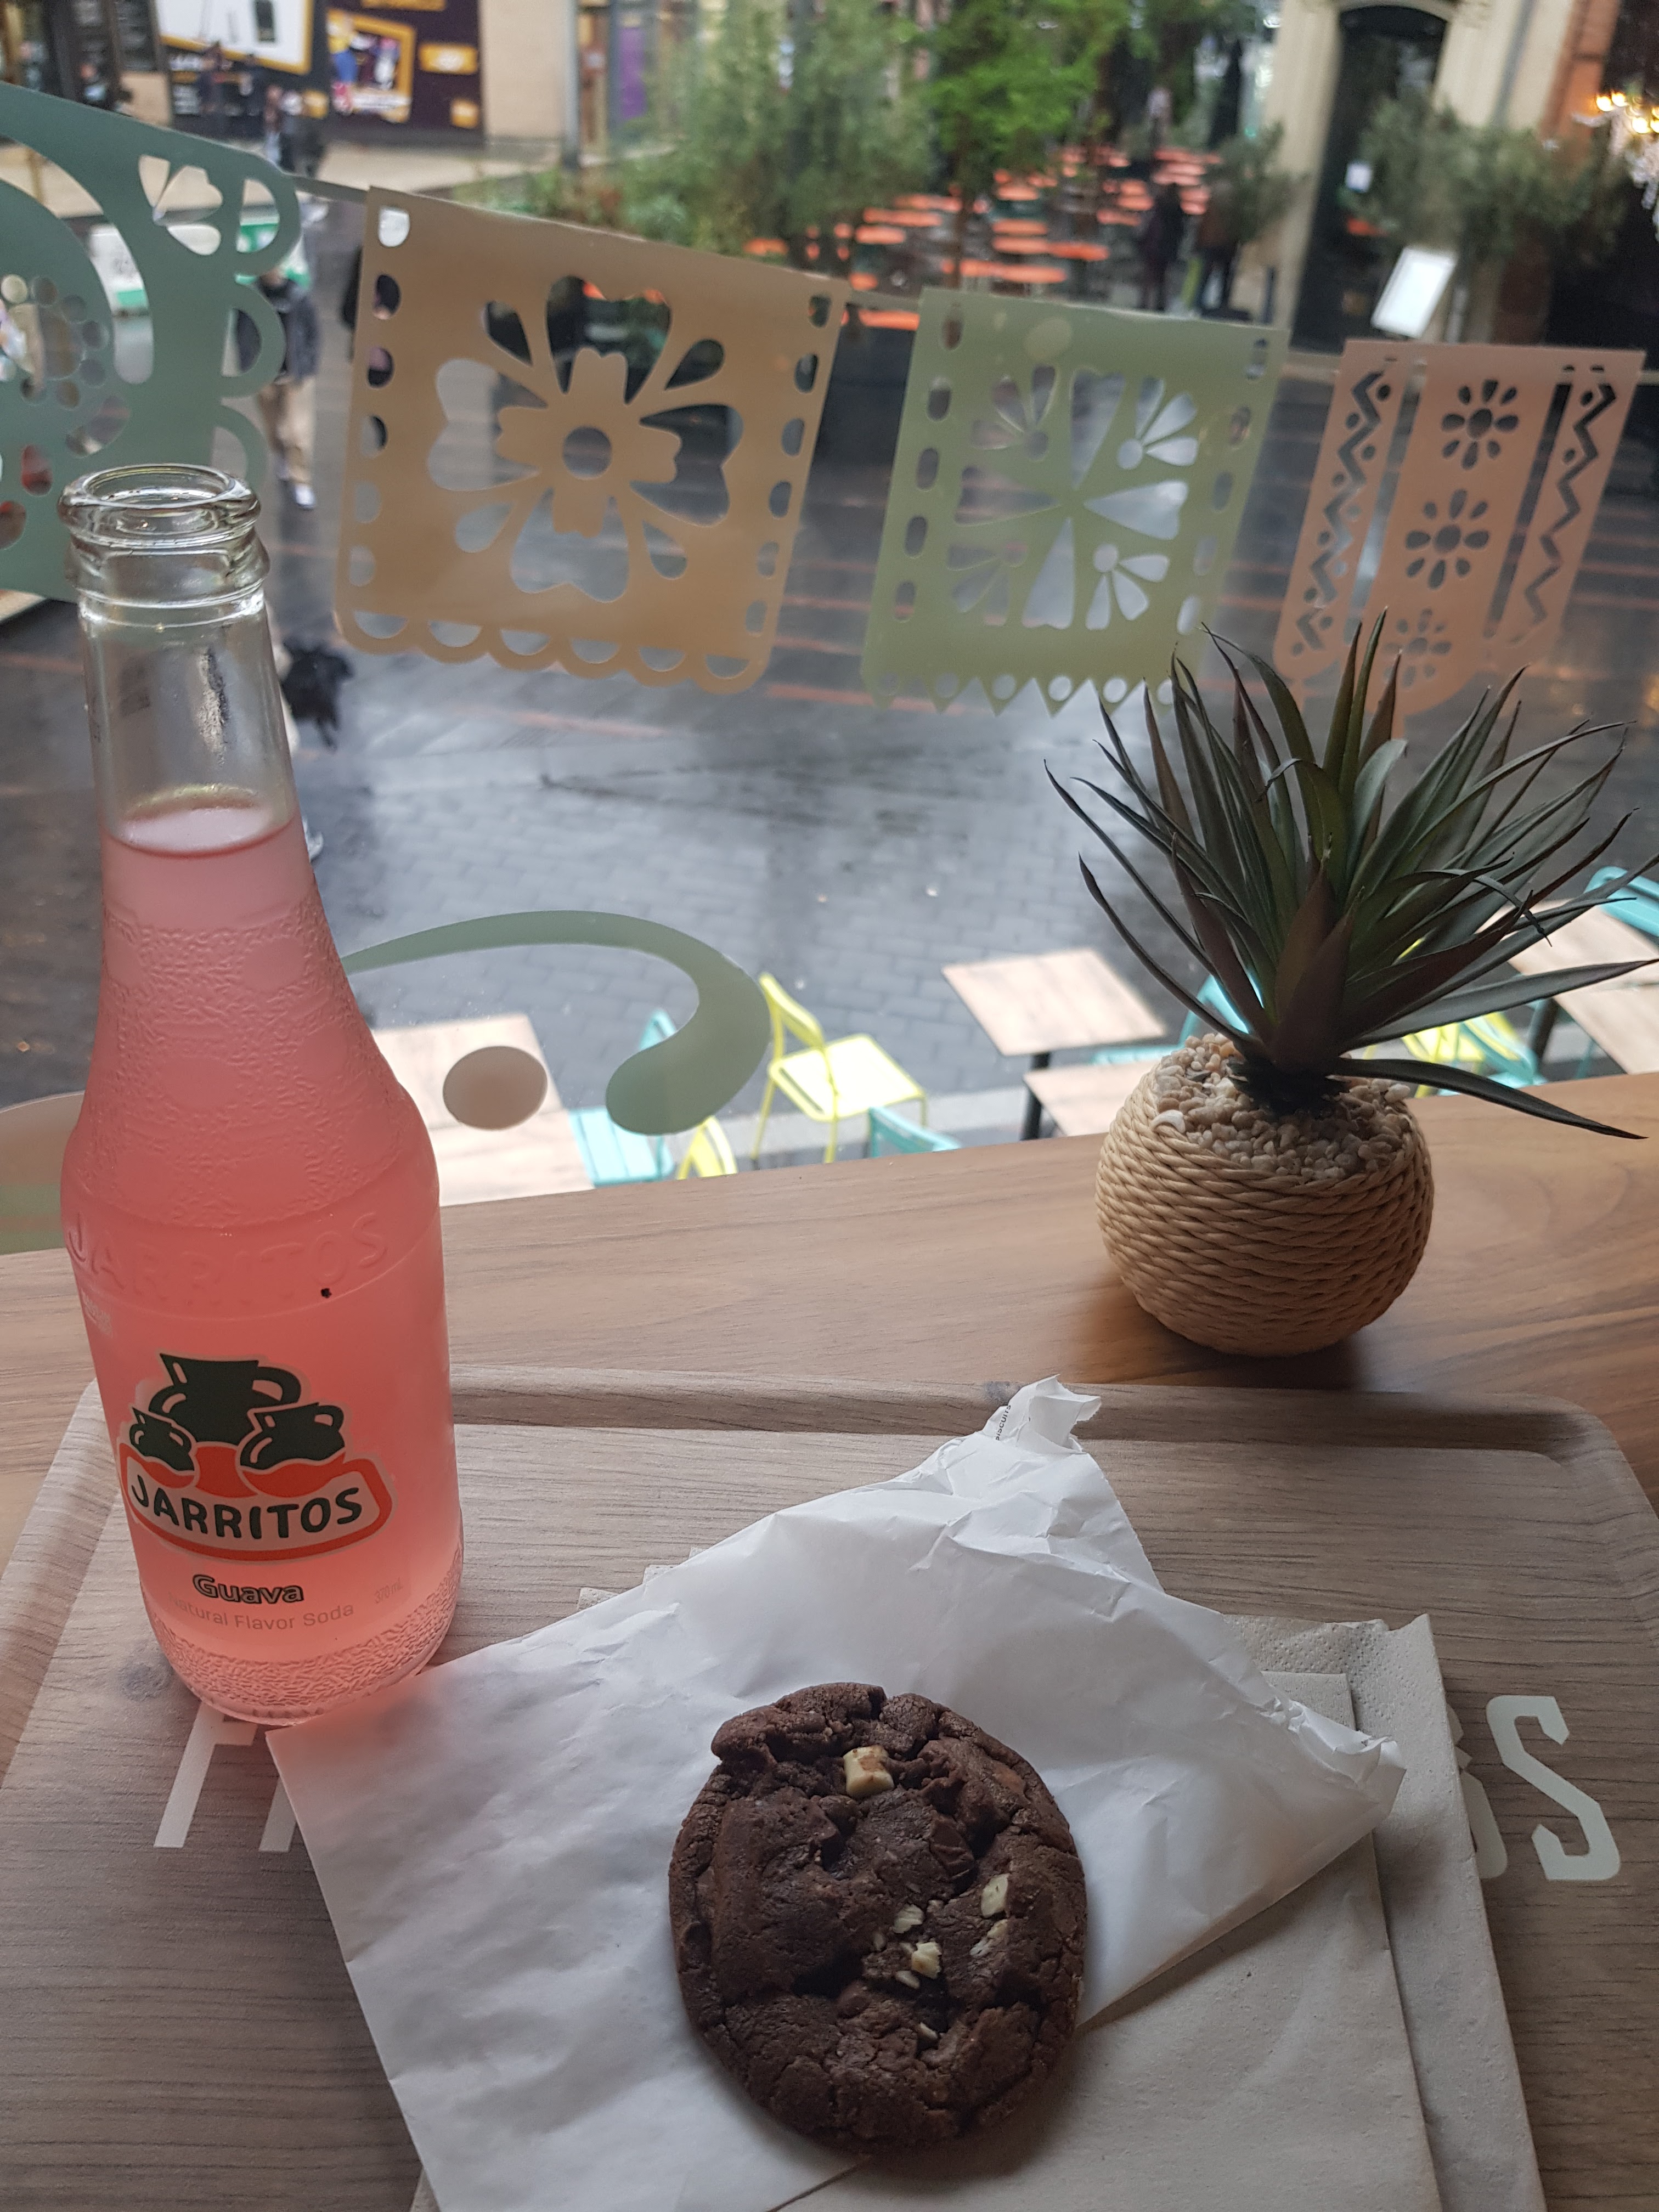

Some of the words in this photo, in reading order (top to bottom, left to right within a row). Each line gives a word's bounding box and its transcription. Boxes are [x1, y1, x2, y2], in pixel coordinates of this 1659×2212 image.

[131, 1474, 362, 1539] JARRITOS
[192, 1573, 304, 1604] Guava
[168, 1592, 228, 1626] Natural
[234, 1615, 295, 1630] Flavor
[303, 1604, 354, 1627] Soda
